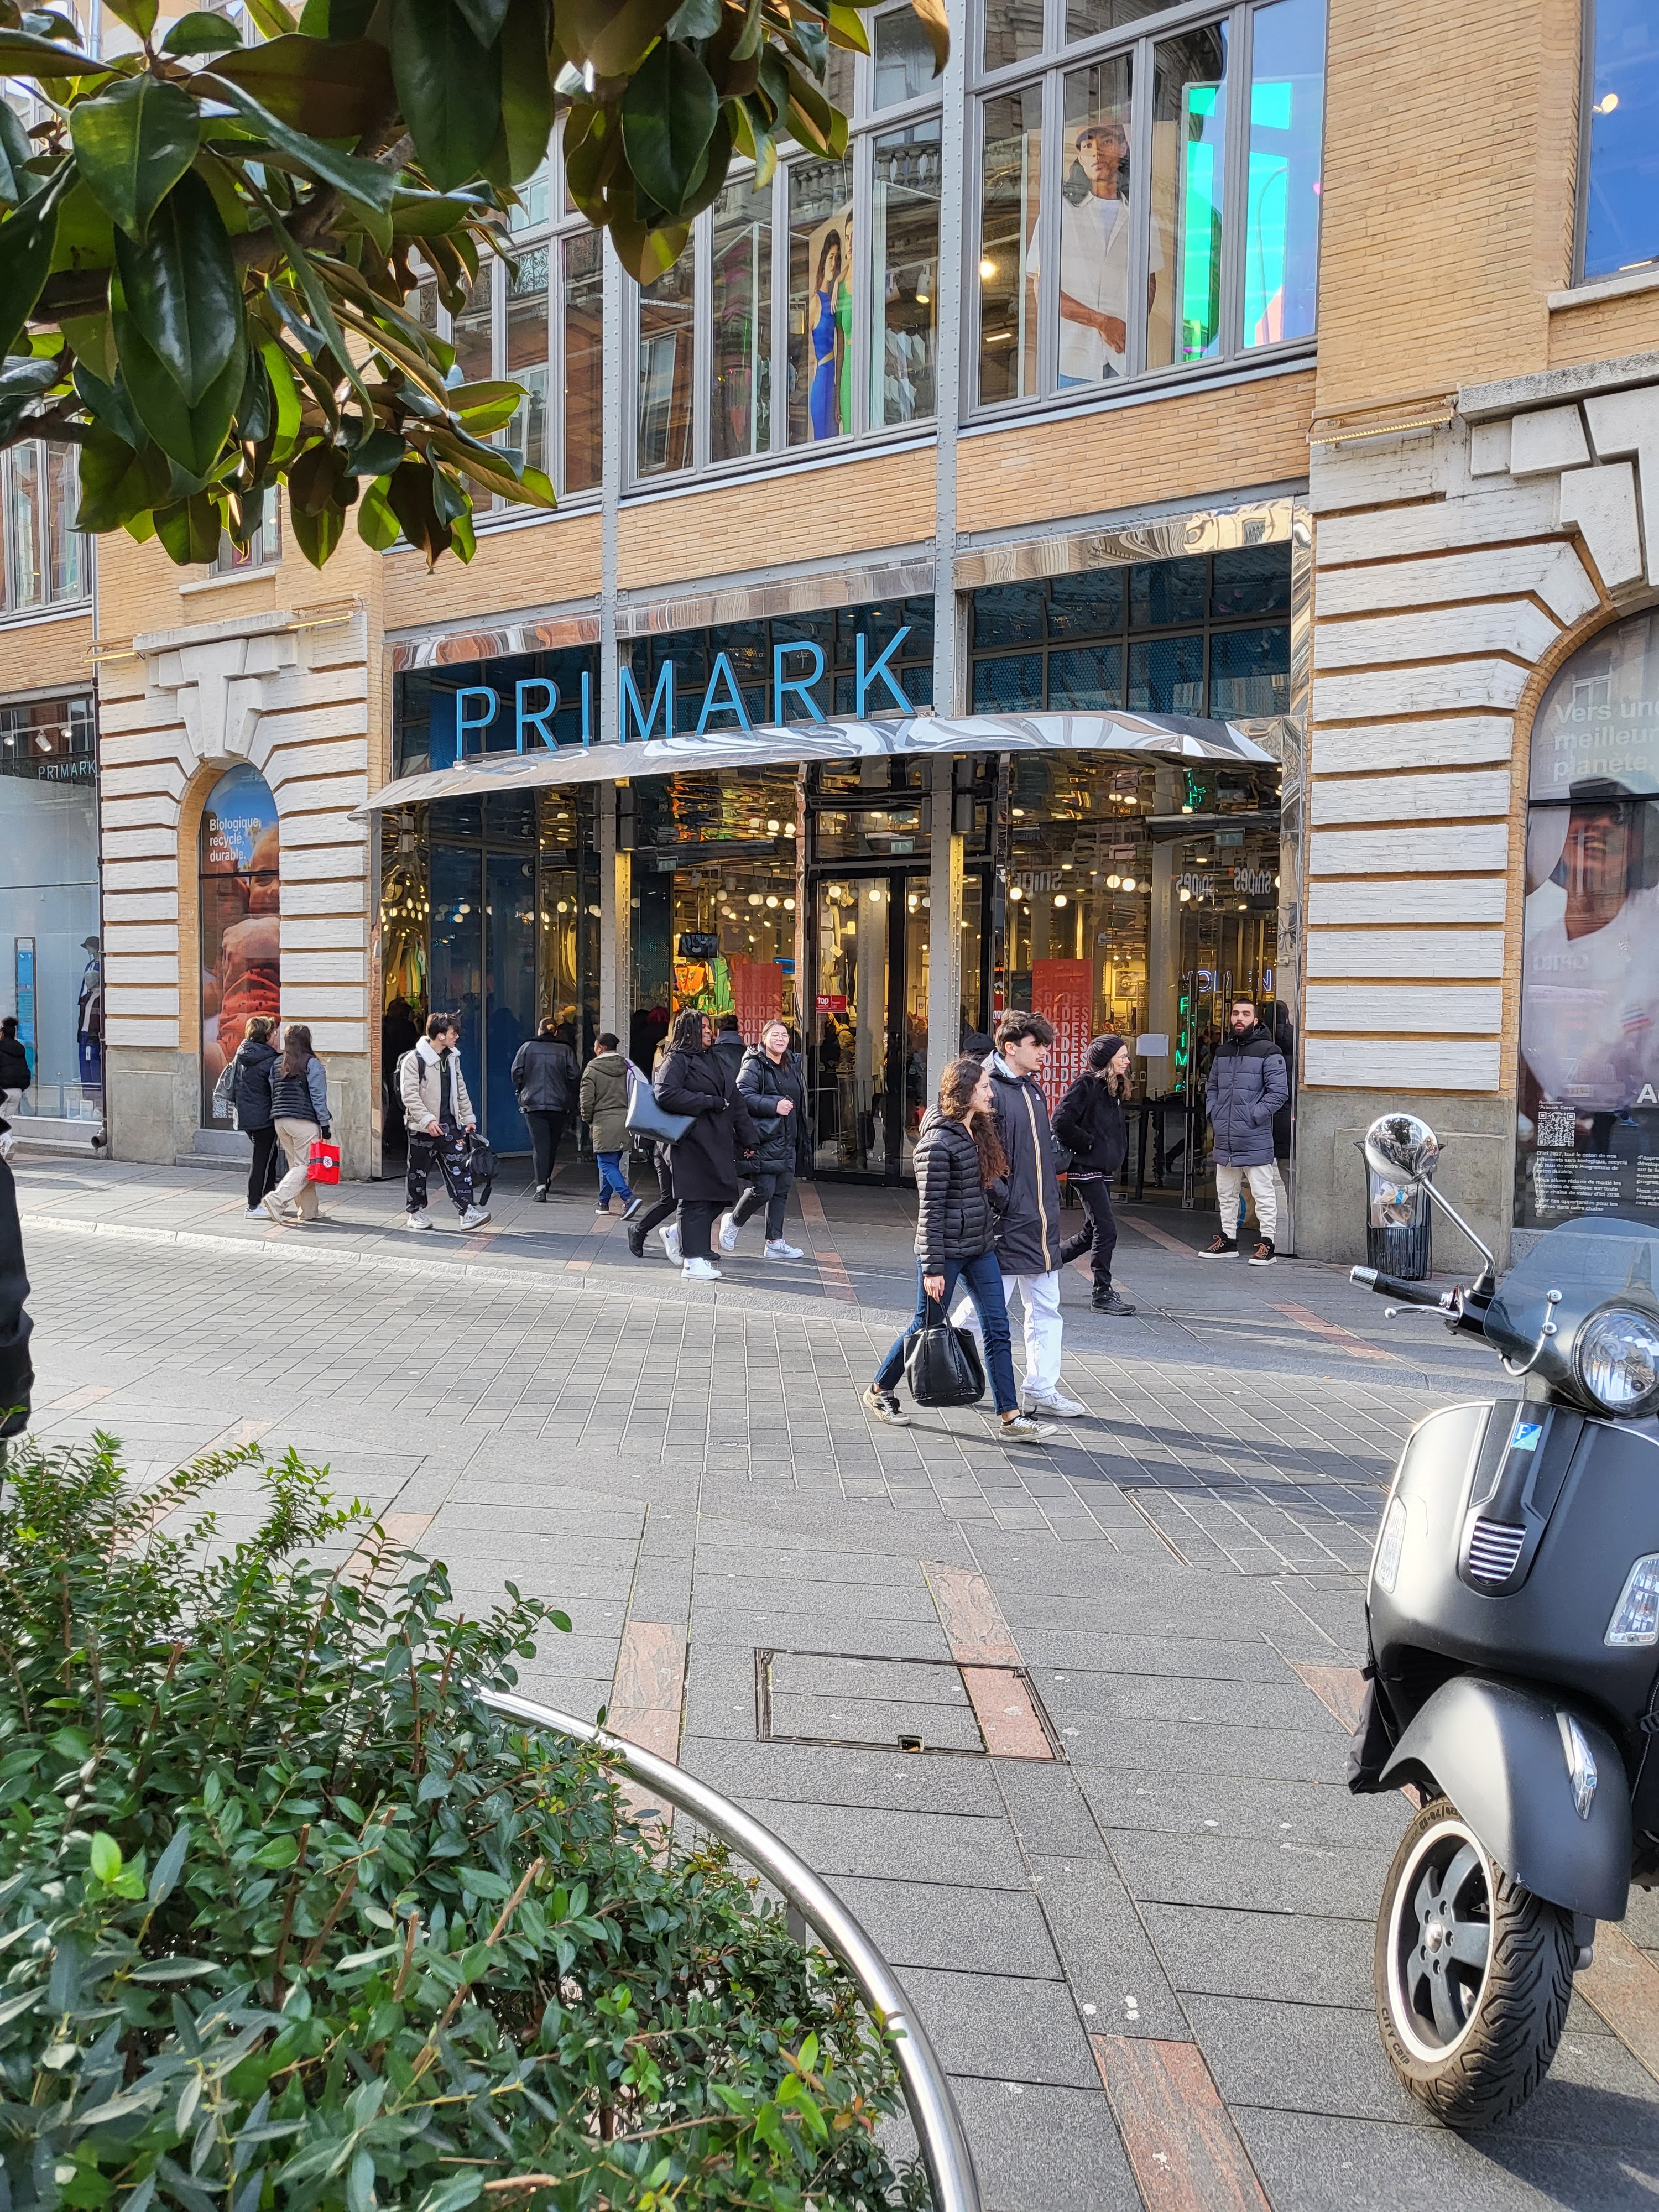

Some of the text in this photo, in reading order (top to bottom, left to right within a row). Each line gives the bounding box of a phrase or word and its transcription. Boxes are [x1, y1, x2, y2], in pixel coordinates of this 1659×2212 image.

[456, 625, 917, 761] PRIMARK
[1555, 703, 1611, 724] Vers
[1554, 726, 1659, 750] meilleur
[38, 759, 96, 780] PRIMARK
[1554, 752, 1654, 782] planète.
[210, 816, 261, 832] Biologique,
[210, 832, 244, 848] recyclé,
[210, 848, 246, 862] durable.
[817, 997, 829, 1005] top
[736, 1005, 781, 1019] SOLDES
[737, 1019, 772, 1032] SOLD
[1053, 1022, 1088, 1036] LDES
[738, 1032, 763, 1046] OLD
[1045, 1037, 1088, 1052] LDES
[1042, 1052, 1087, 1067] OLDES
[1035, 1082, 1071, 1097] OLD
[1636, 1083, 1659, 1104] A
[1381, 2007, 1410, 2065] CITY GRIP
